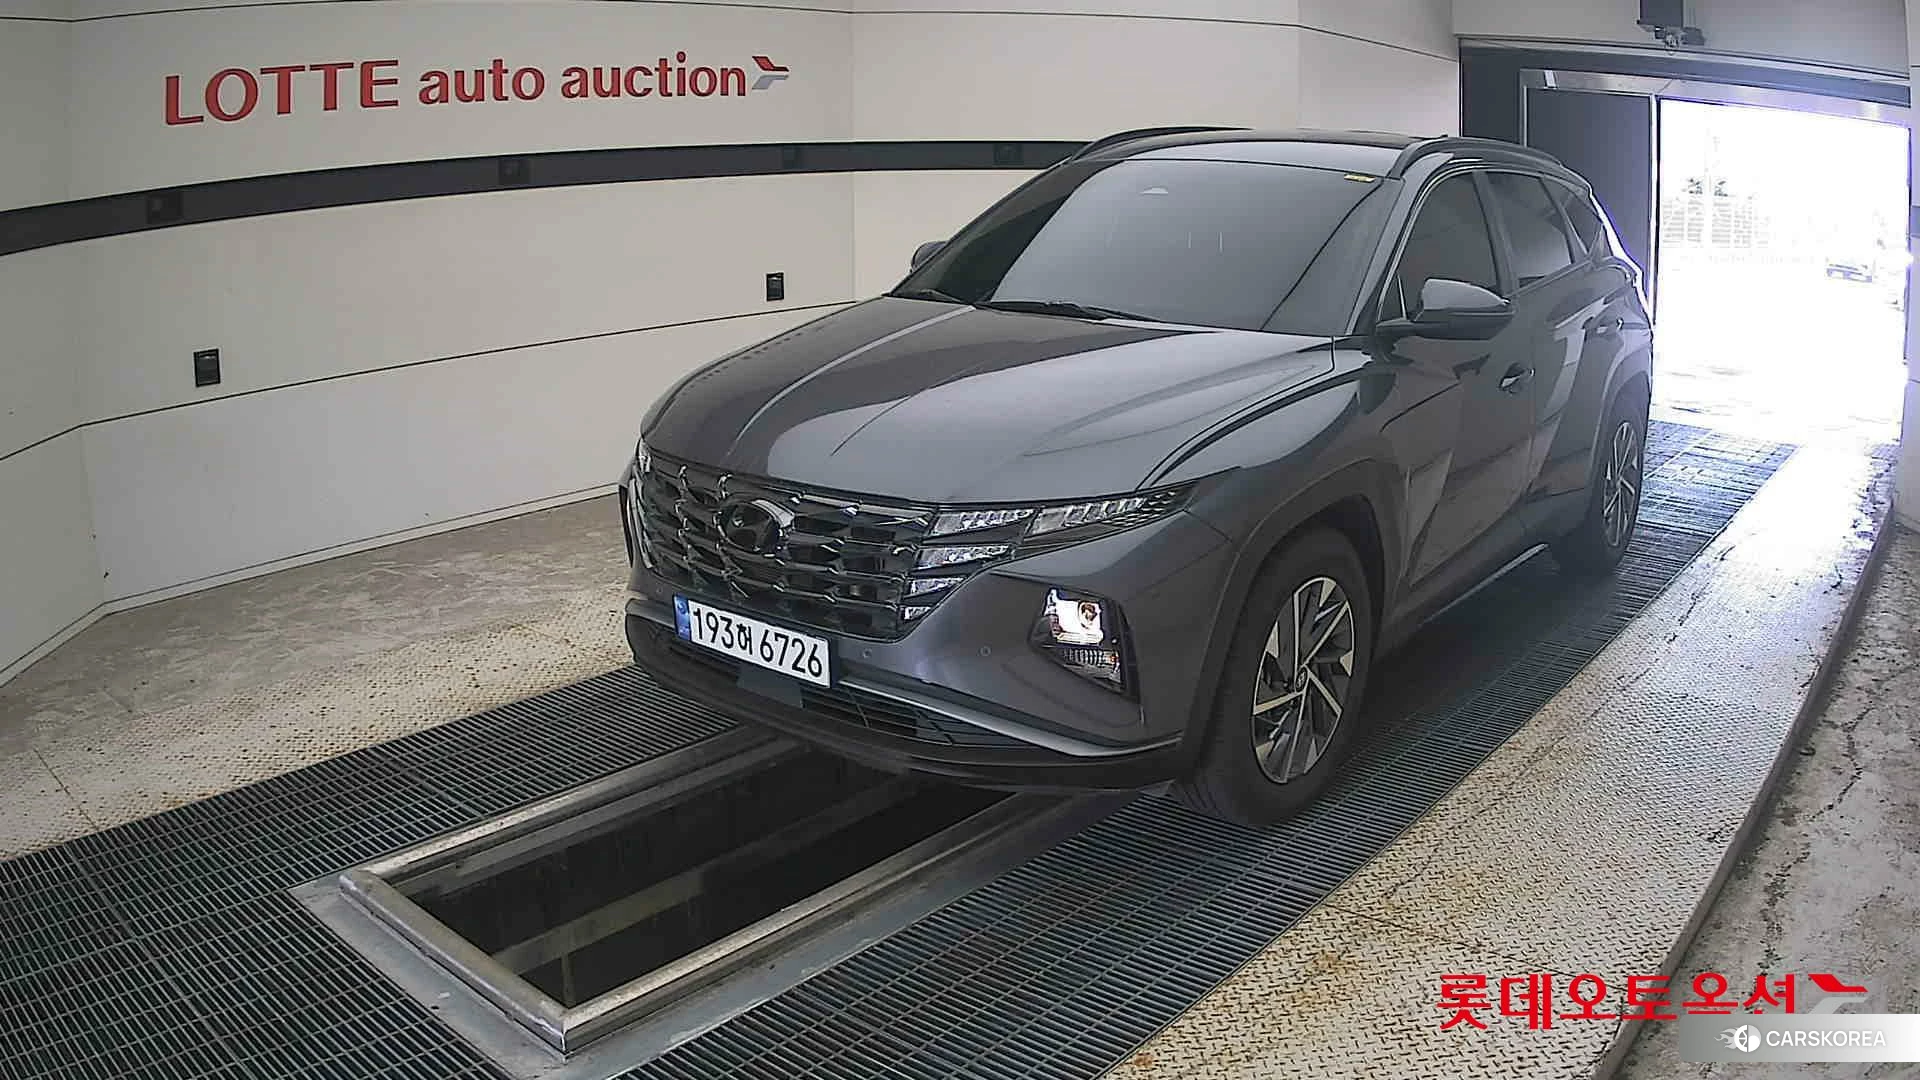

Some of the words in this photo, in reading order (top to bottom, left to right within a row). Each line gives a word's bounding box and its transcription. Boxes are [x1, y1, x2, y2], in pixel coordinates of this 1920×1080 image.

[164, 59, 400, 126] LOTTE
[418, 58, 546, 105] auto
[561, 51, 747, 99] auction
[693, 607, 753, 655] 193허
[759, 629, 823, 678] 6726
